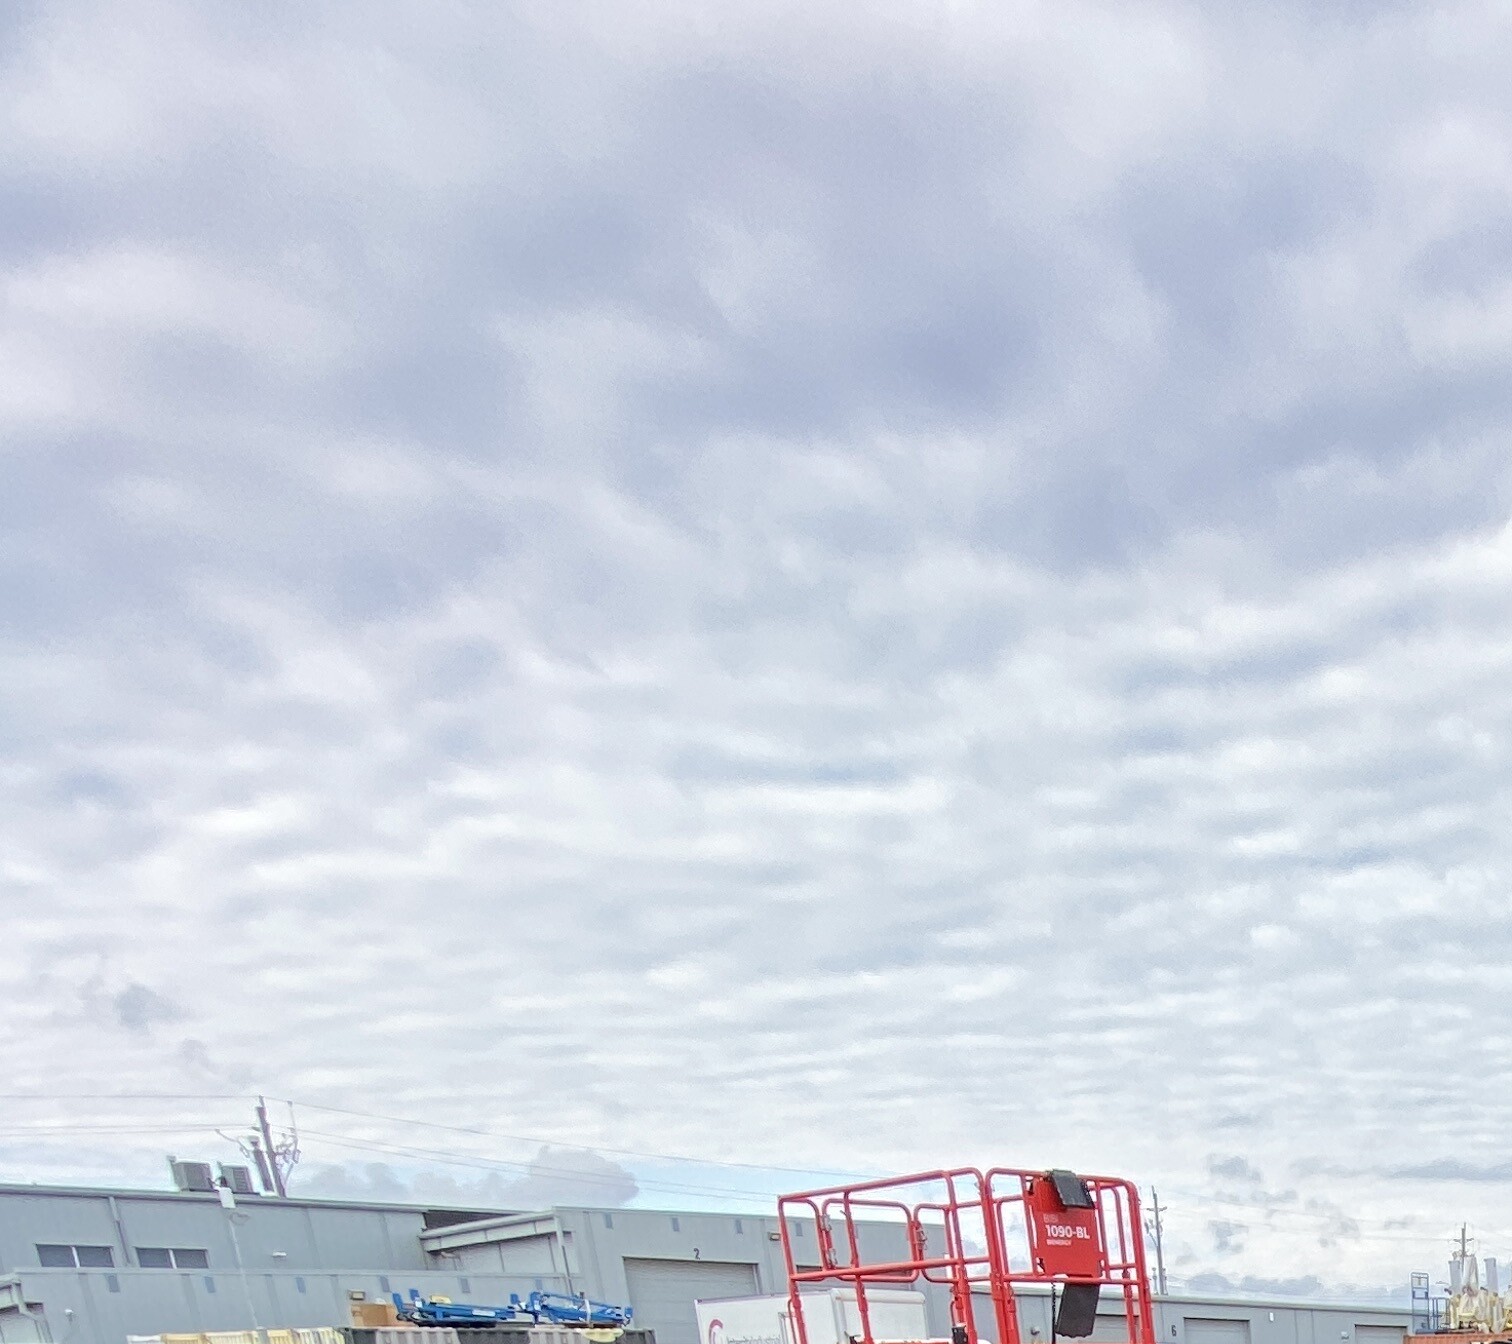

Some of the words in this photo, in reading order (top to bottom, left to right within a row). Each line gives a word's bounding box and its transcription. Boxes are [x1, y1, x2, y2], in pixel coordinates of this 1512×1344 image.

[1045, 1224, 1090, 1239] 1090-BL
[693, 1248, 700, 1260] 2
[1171, 1324, 1177, 1336] 6
